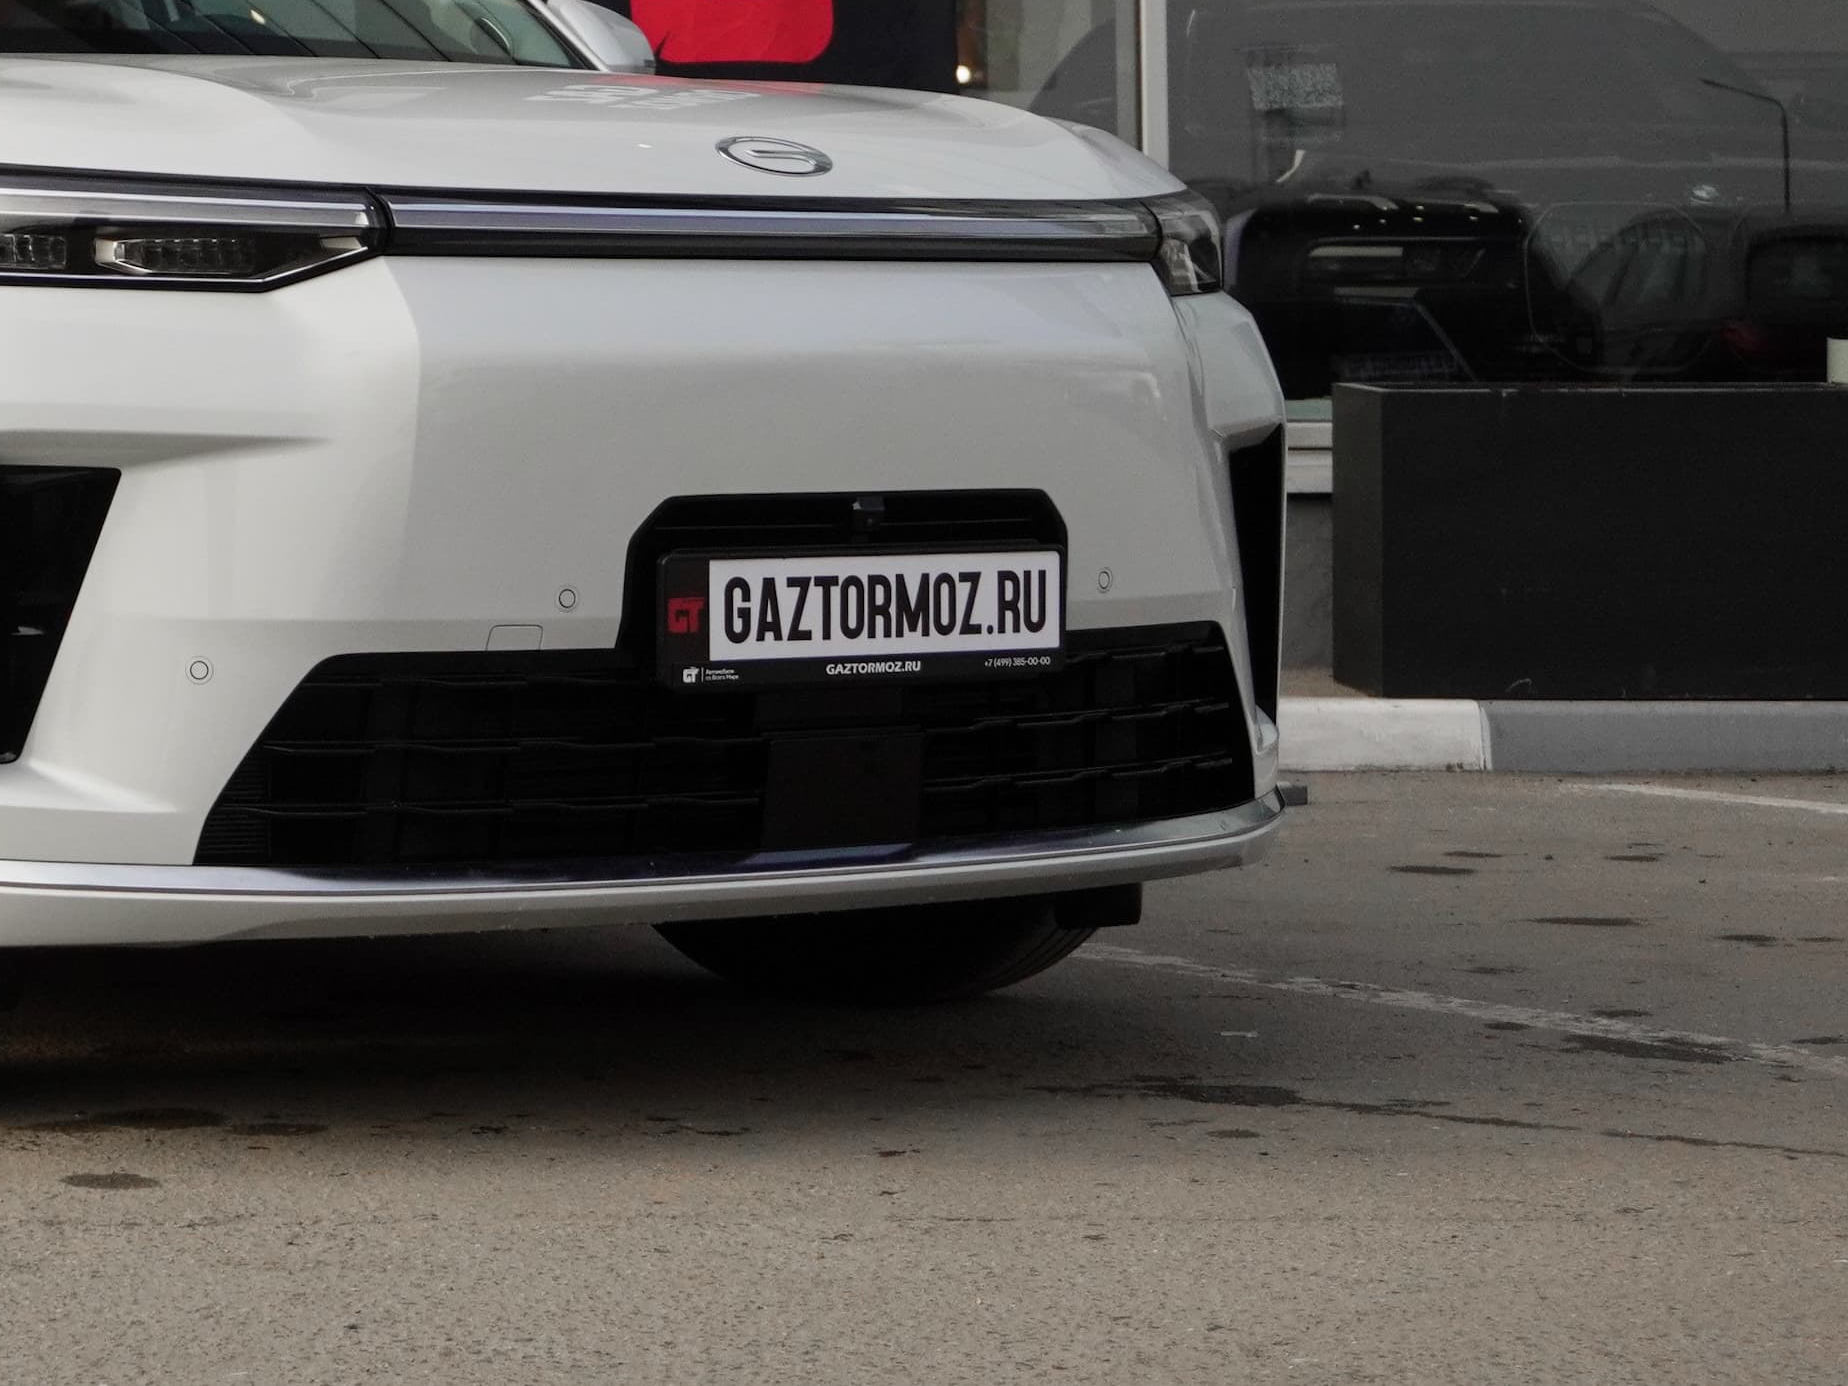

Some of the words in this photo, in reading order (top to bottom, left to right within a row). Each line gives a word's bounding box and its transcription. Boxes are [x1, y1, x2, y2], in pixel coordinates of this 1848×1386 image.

[666, 596, 705, 634] GT
[723, 569, 1047, 645] GAZTORMOZ.RU
[825, 660, 921, 675] GAZTORMOZ.RU
